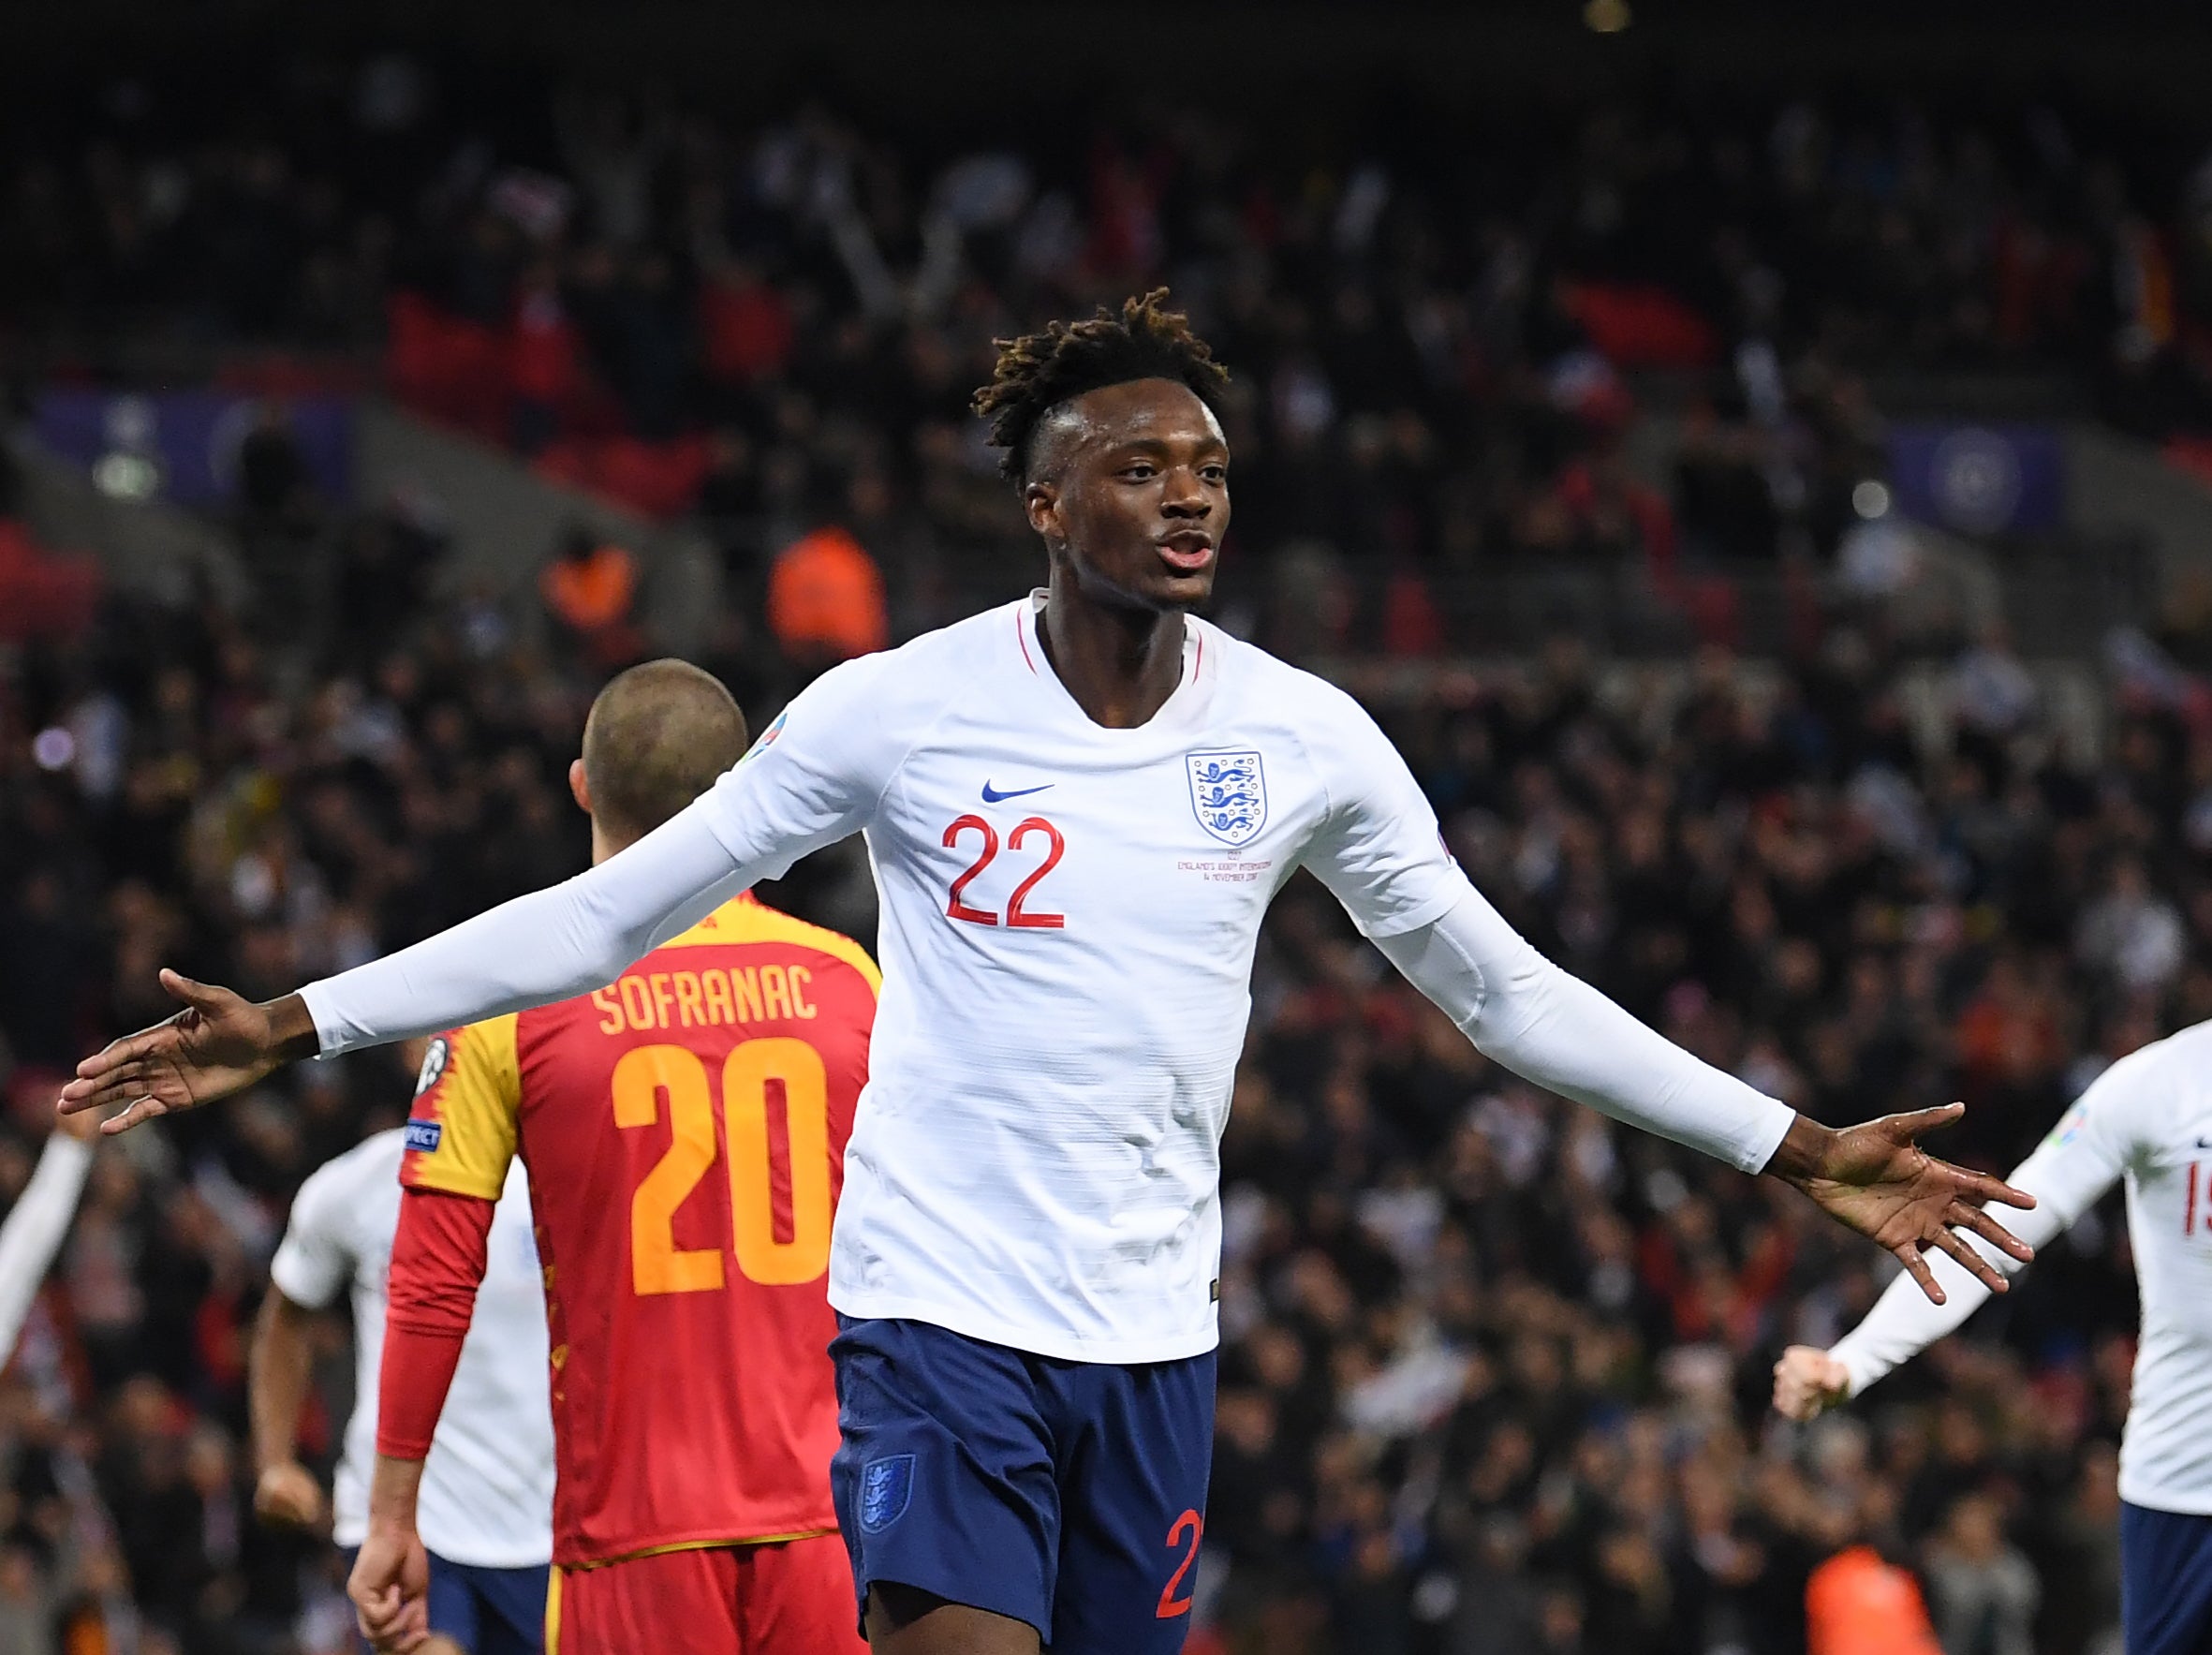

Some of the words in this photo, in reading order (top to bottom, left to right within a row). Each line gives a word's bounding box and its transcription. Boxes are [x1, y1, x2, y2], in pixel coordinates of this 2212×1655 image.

[942, 814, 1065, 928] 22
[591, 964, 818, 1035] SOFRANAC
[611, 1036, 833, 1296] 20
[1156, 1508, 1202, 1618] 2
